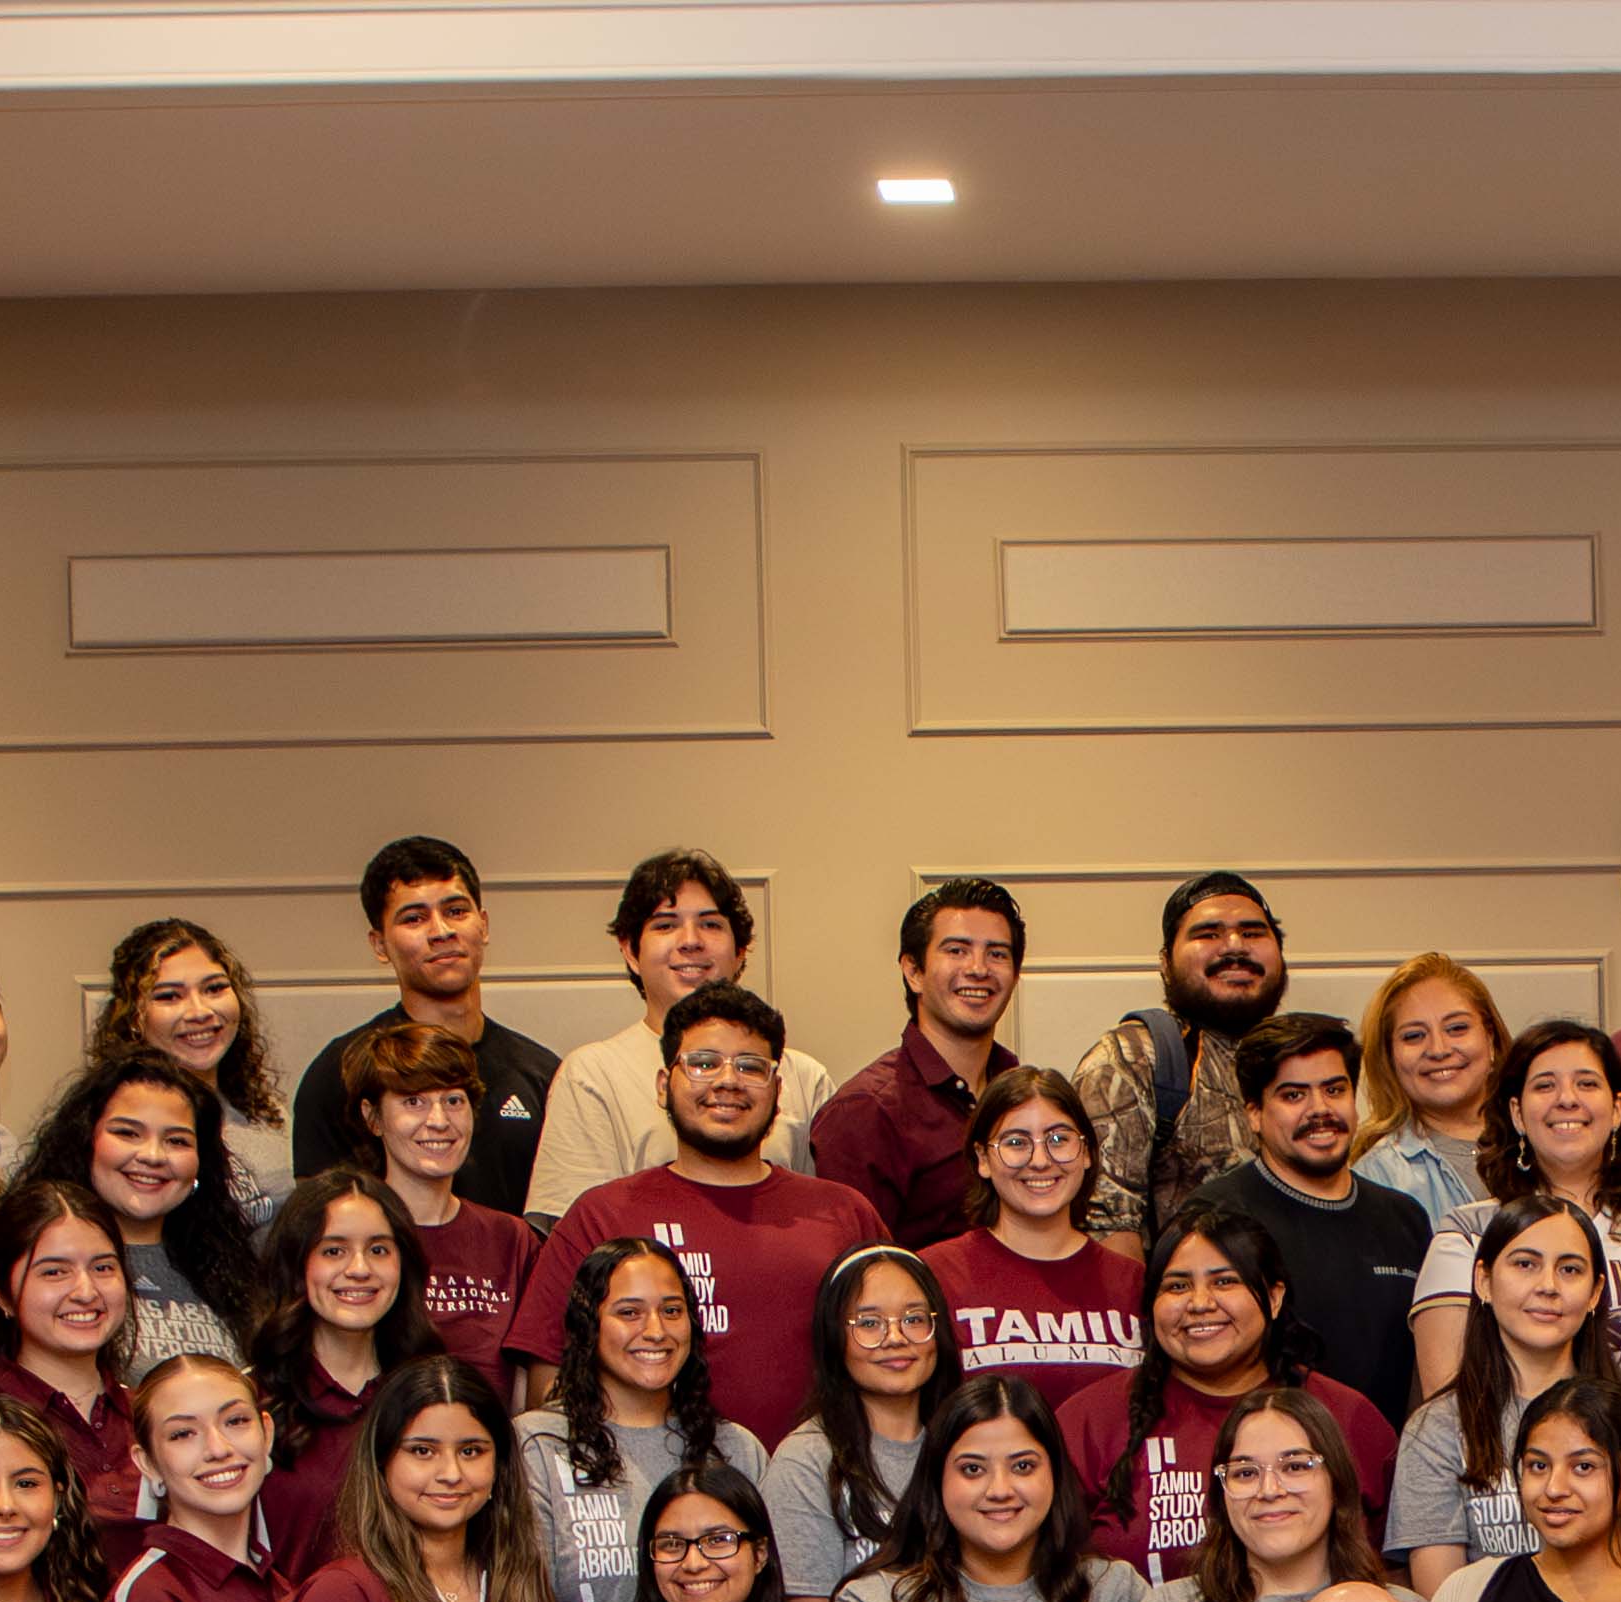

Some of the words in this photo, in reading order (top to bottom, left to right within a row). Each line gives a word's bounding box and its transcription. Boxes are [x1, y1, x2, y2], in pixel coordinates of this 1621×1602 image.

[678, 1252, 712, 1277] MIU
[425, 1287, 511, 1302] NATIONAL
[425, 1300, 498, 1313] VERSITY
[698, 1304, 729, 1333] OAD
[956, 1307, 1143, 1348] TAMIU
[1149, 1471, 1202, 1496] TAMIU
[565, 1494, 620, 1520] TAMIU
[1149, 1493, 1206, 1521] STUDY
[1470, 1493, 1521, 1525] STUDY
[572, 1520, 627, 1549] STUDY
[1148, 1517, 1207, 1550] ABROA
[1478, 1523, 1540, 1553] ABROAD
